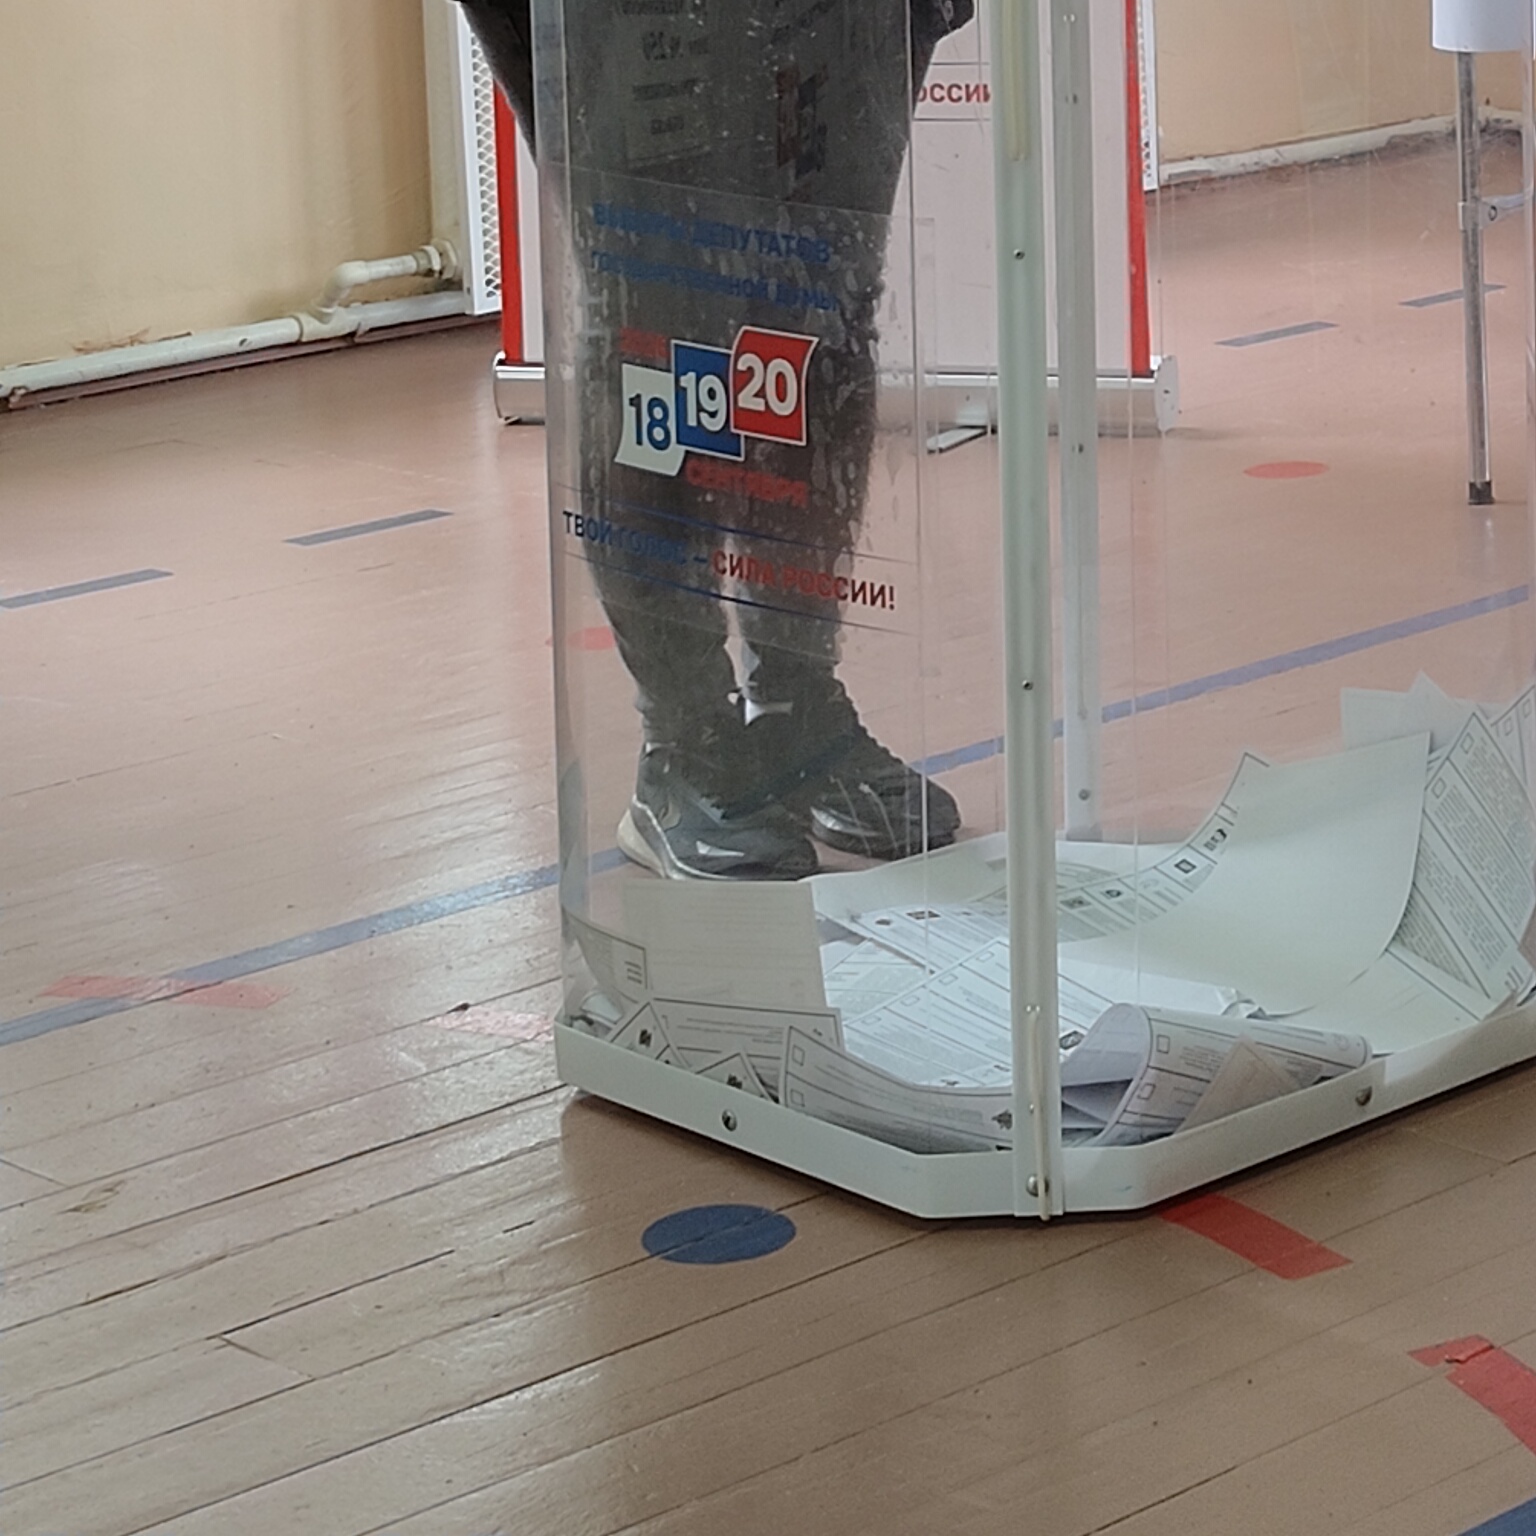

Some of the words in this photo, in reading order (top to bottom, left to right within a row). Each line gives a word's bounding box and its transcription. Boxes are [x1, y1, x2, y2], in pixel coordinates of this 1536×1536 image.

[680, 371, 728, 432] 19
[737, 353, 798, 416] 20
[629, 394, 672, 451] 18
[713, 551, 777, 586] СИЛА
